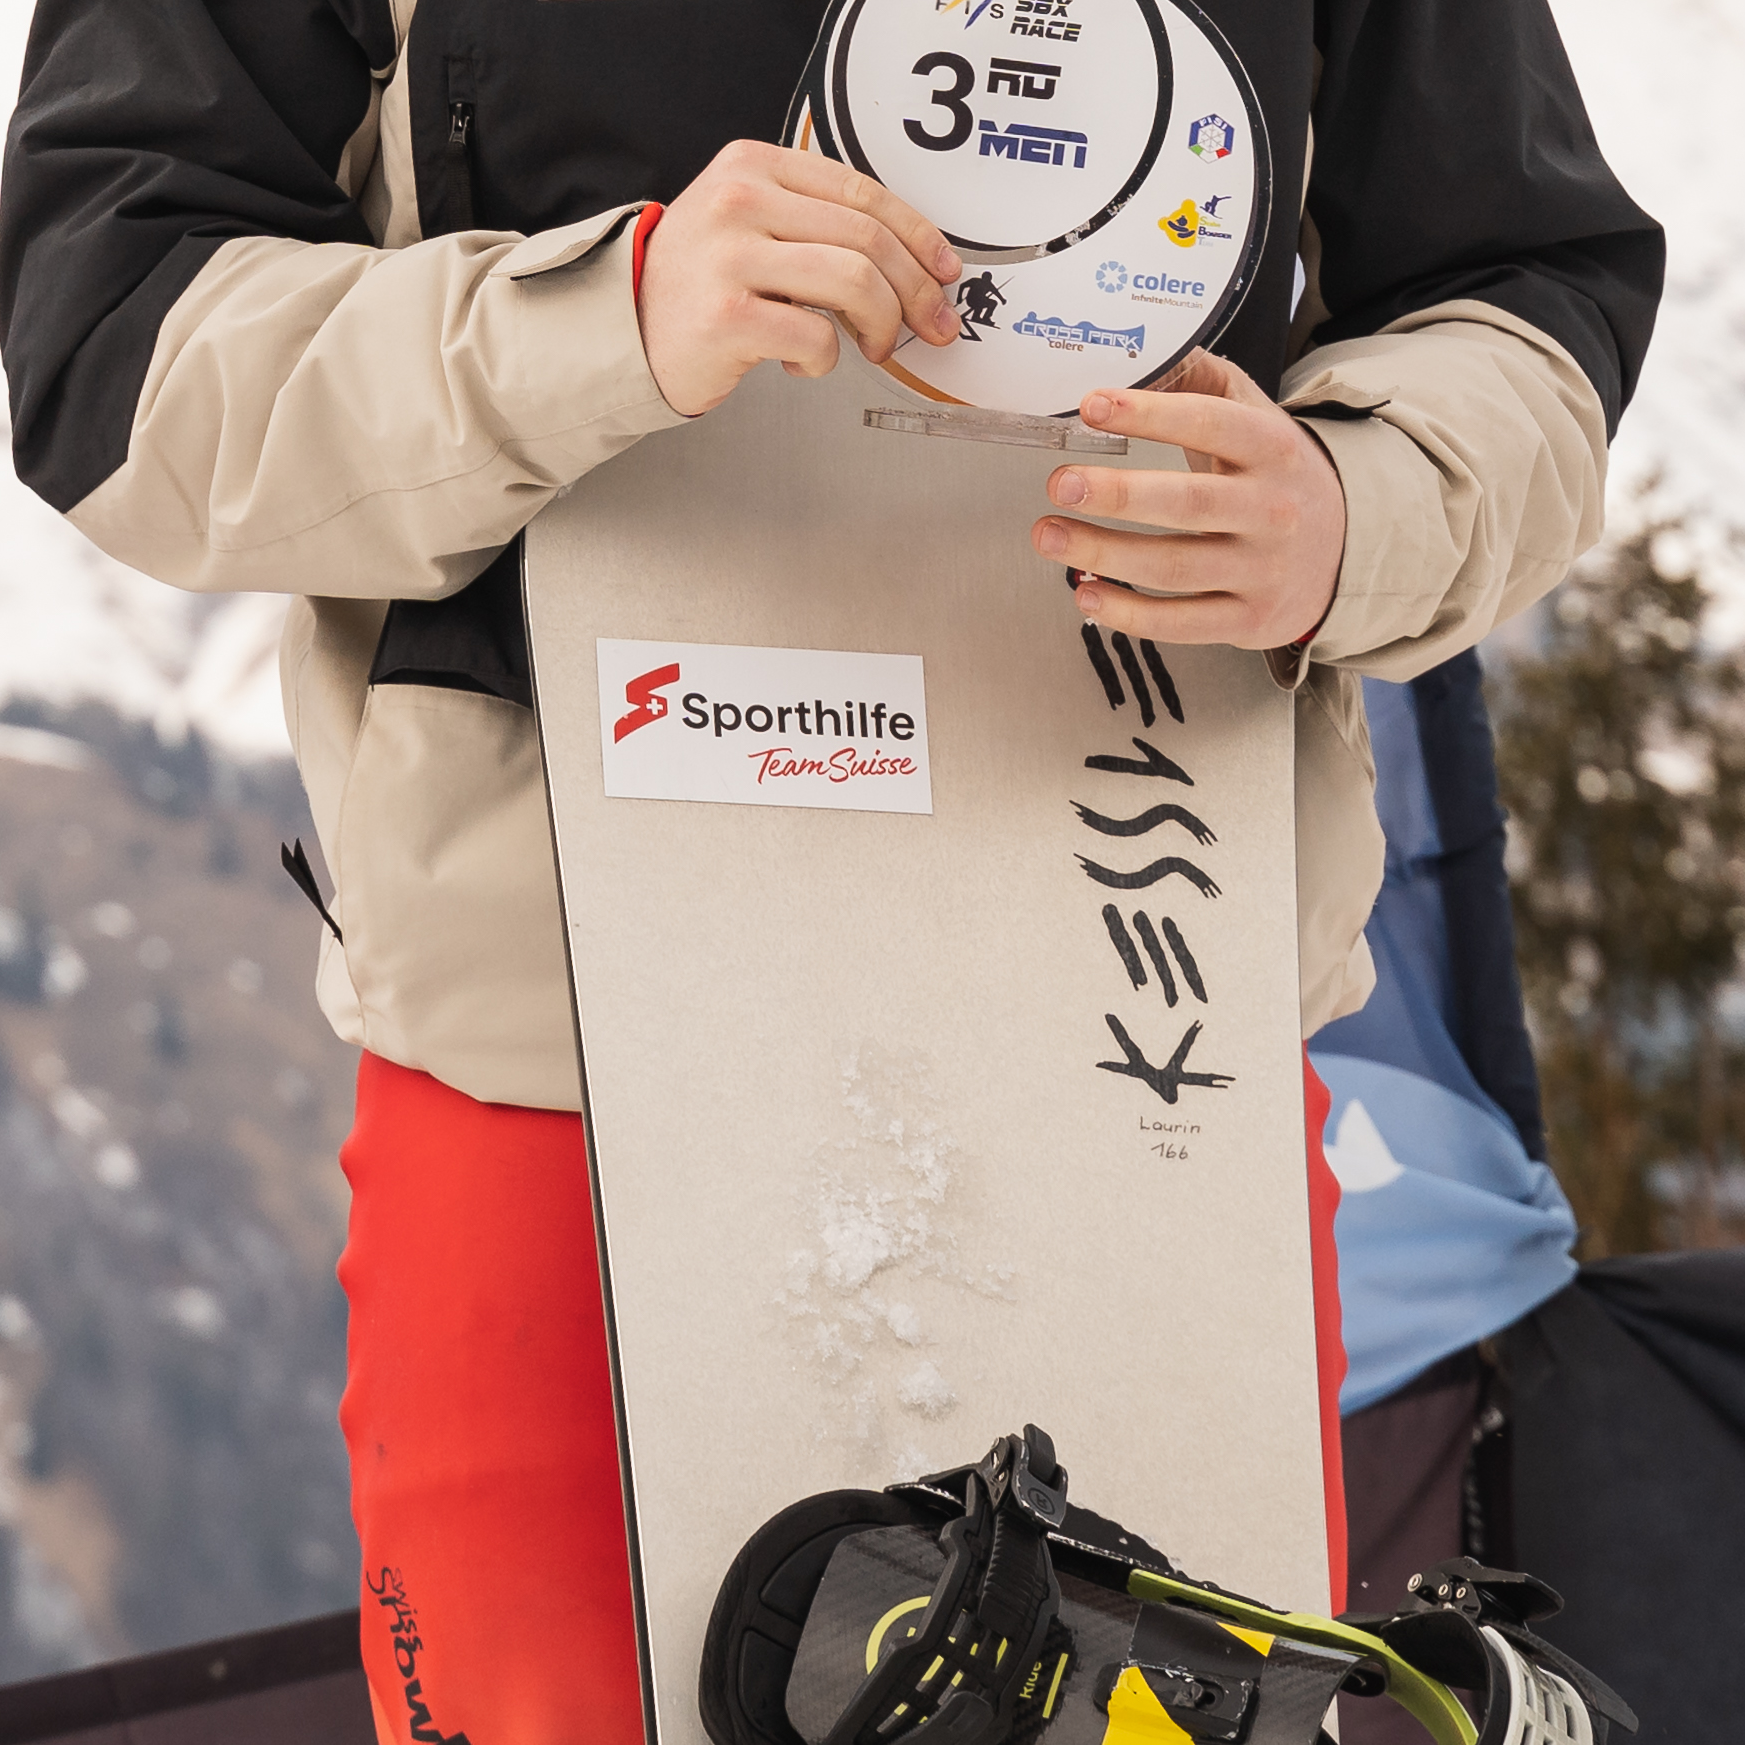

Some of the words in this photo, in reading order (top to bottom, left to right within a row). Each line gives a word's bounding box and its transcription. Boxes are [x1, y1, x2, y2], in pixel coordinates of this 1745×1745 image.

[1009, 16, 1083, 43] RACE
[902, 51, 976, 152] 3
[1198, 116, 1228, 130] FISI
[977, 119, 1089, 169] MEN
[1132, 272, 1206, 297] colere
[1020, 320, 1085, 343] CROSS
[1087, 329, 1141, 352] PARK
[1048, 339, 1085, 352] colere
[681, 692, 916, 741] Sporthilfe
[1066, 563, 1237, 1105] KESSLE
[1150, 1141, 1189, 1160] 166
